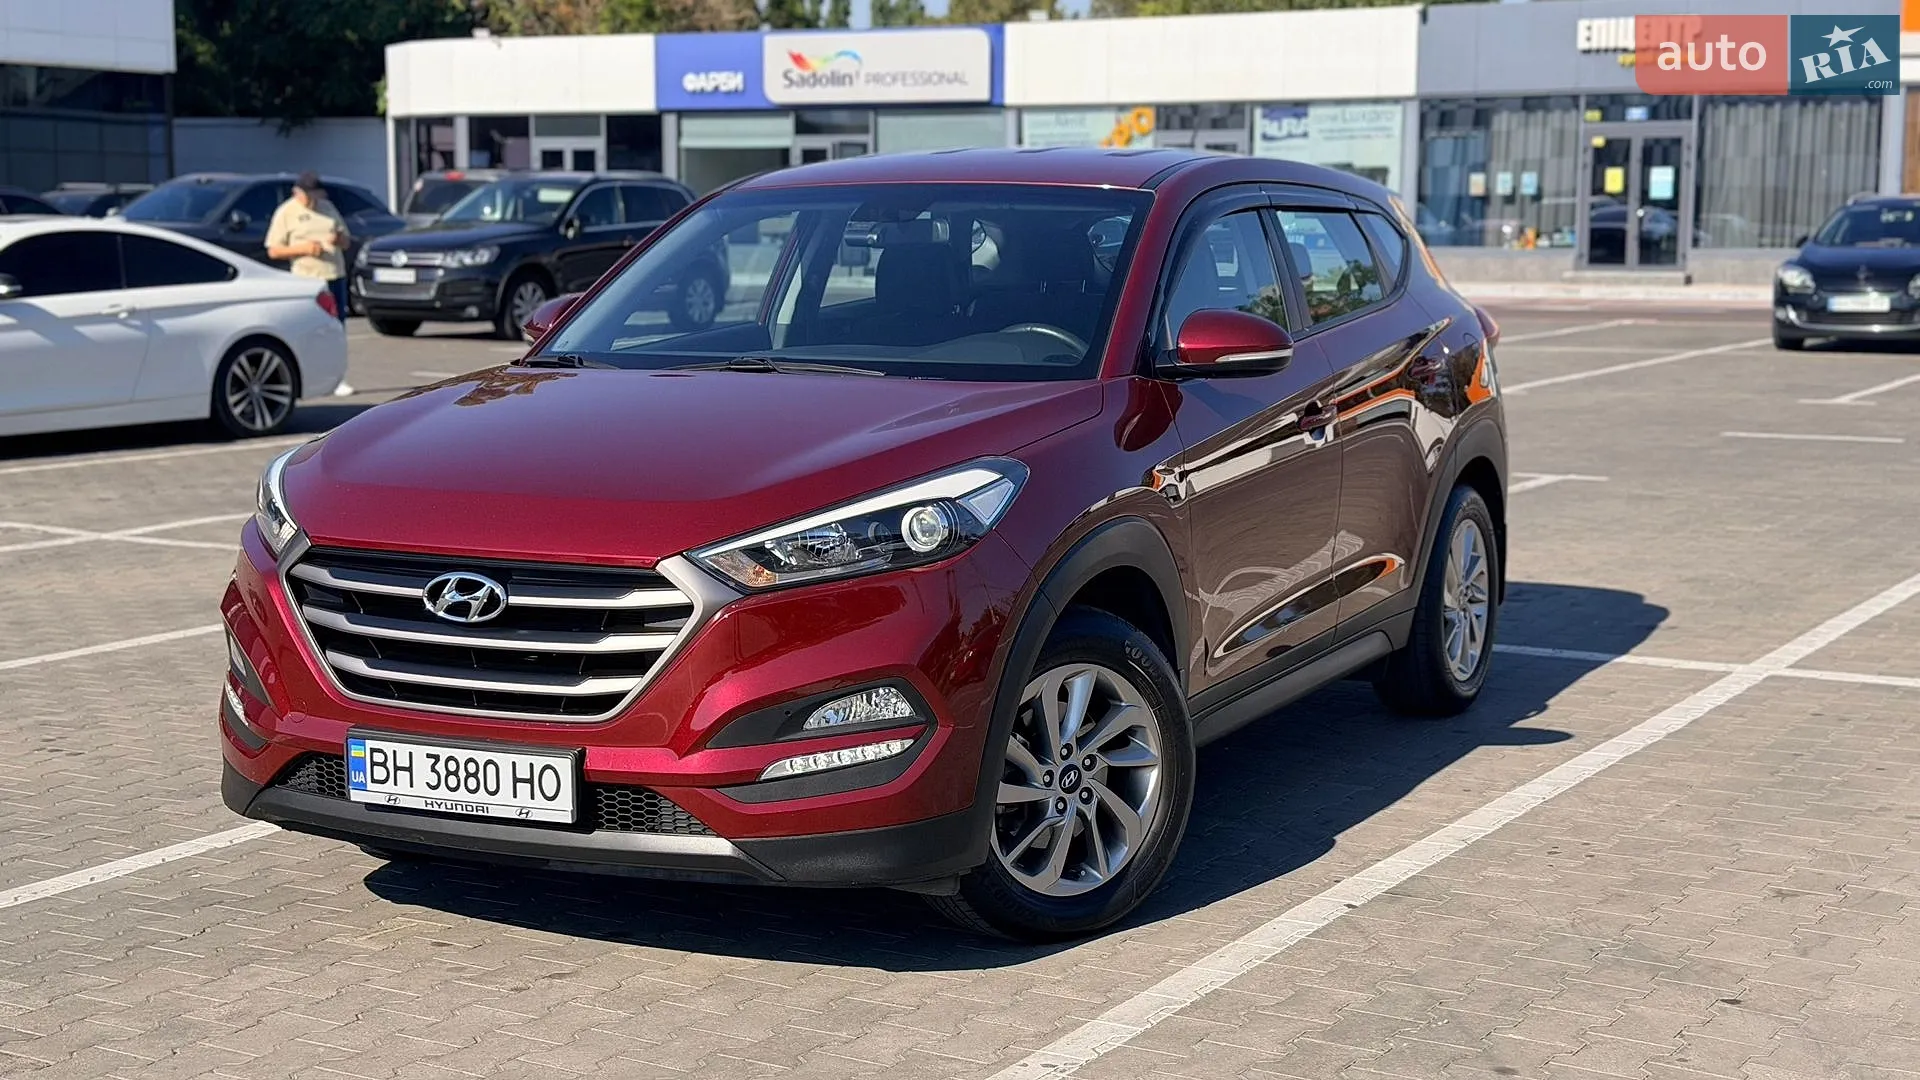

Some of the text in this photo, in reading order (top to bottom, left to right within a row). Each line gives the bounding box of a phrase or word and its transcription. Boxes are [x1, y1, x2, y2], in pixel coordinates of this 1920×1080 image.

[783, 69, 969, 89] Sadolin PROFESSIONAL
[352, 770, 366, 784] UA
[369, 747, 561, 802] BH 3880 HO
[424, 799, 490, 815] HYUNDAI
